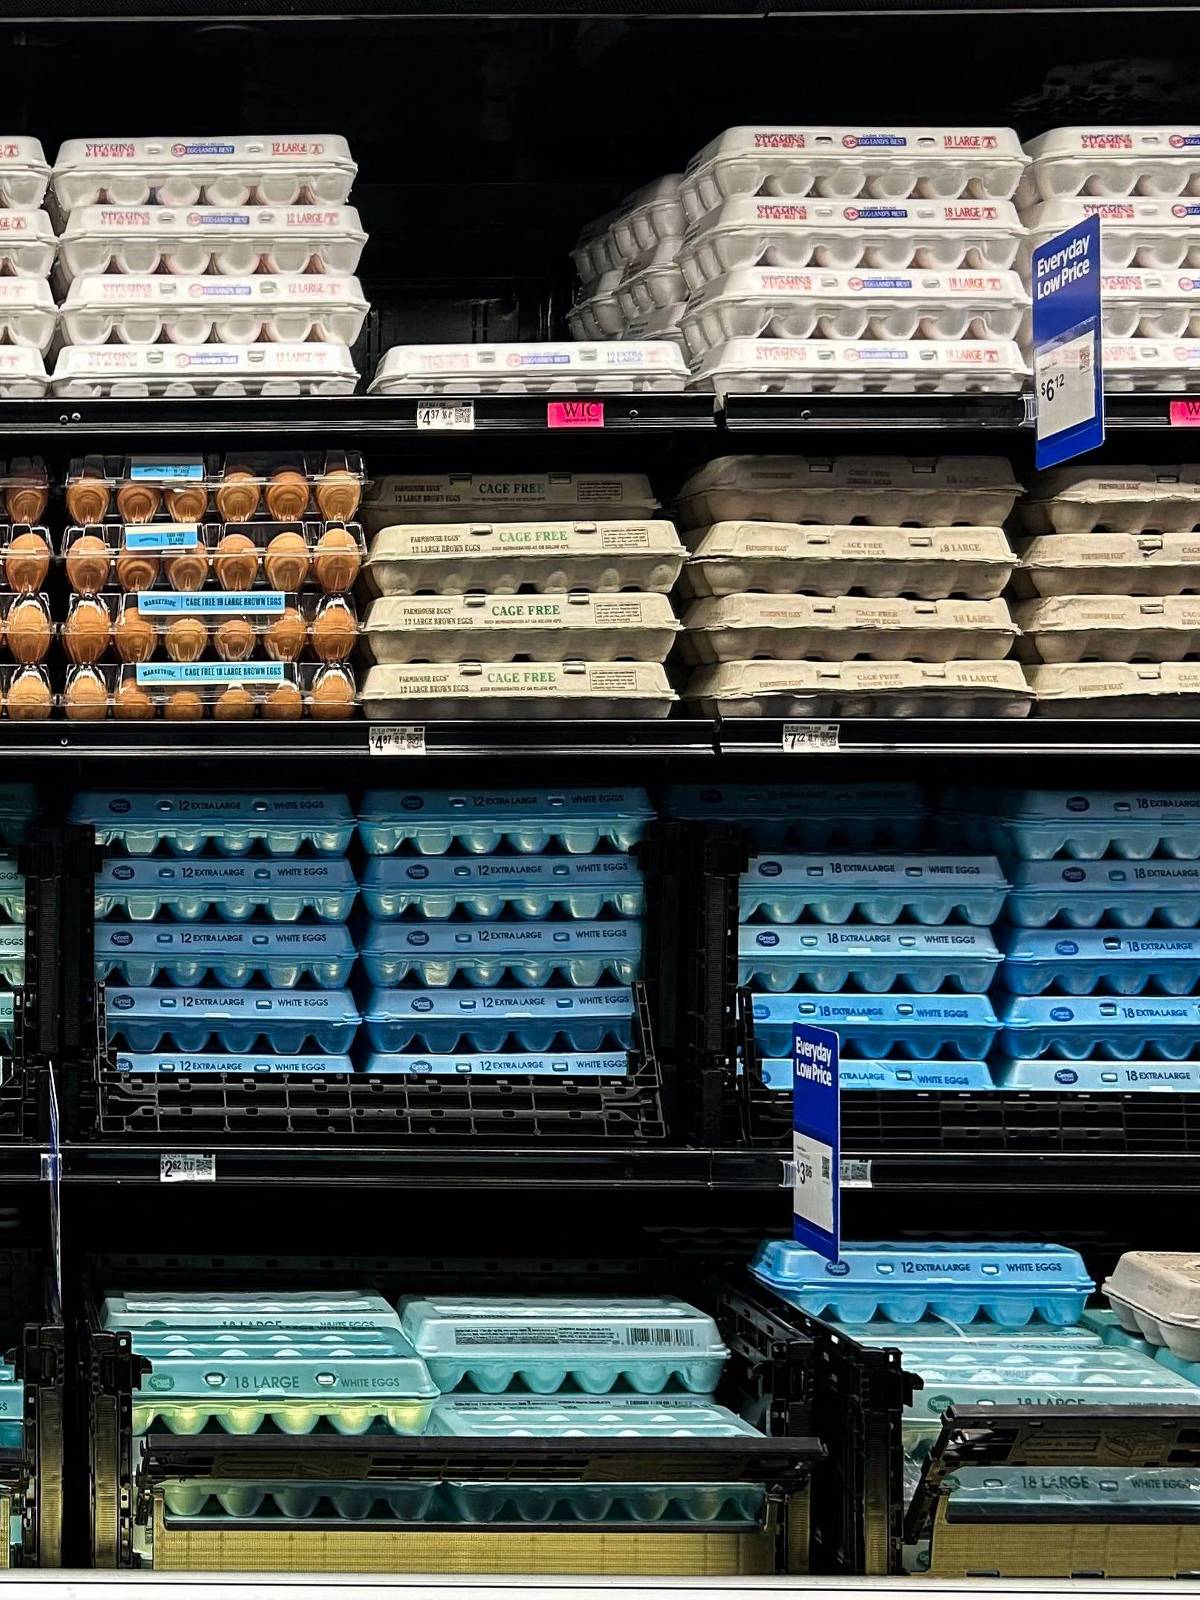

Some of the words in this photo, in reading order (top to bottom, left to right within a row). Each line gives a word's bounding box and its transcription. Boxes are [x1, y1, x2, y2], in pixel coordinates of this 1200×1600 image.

[944, 136, 952, 145] 18
[955, 136, 980, 145] LARGE
[272, 143, 280, 152] 12
[282, 143, 306, 152] LARGE
[944, 208, 952, 217] 18
[955, 208, 980, 217] LARGE
[1037, 234, 1090, 278] Everyday
[1037, 273, 1060, 299] Low
[1062, 258, 1090, 289] Price
[562, 404, 598, 417] WIC
[499, 532, 532, 542] CAGE
[535, 532, 567, 541] FREE
[492, 606, 525, 616] CAGE
[528, 606, 560, 615] FREE
[488, 673, 521, 683] CAGE
[523, 673, 556, 682] FREE
[957, 674, 966, 682] 18
[968, 675, 998, 683] LARGE
[182, 868, 193, 877] 12
[478, 931, 489, 941] 12
[828, 933, 838, 943] 18
[952, 936, 975, 944] EGGS
[182, 997, 193, 1006] 12
[1123, 1008, 1134, 1017] 18
[1160, 1009, 1188, 1017] LARGE
[796, 1036, 832, 1067] Everyday
[796, 1058, 812, 1079] Low
[812, 1063, 832, 1087] Price
[901, 1262, 914, 1273] 12
[916, 1264, 941, 1272] EXTRA
[942, 1263, 970, 1272] LARGE
[1006, 1264, 1034, 1272] WHITE
[1036, 1264, 1062, 1272] EGGS
